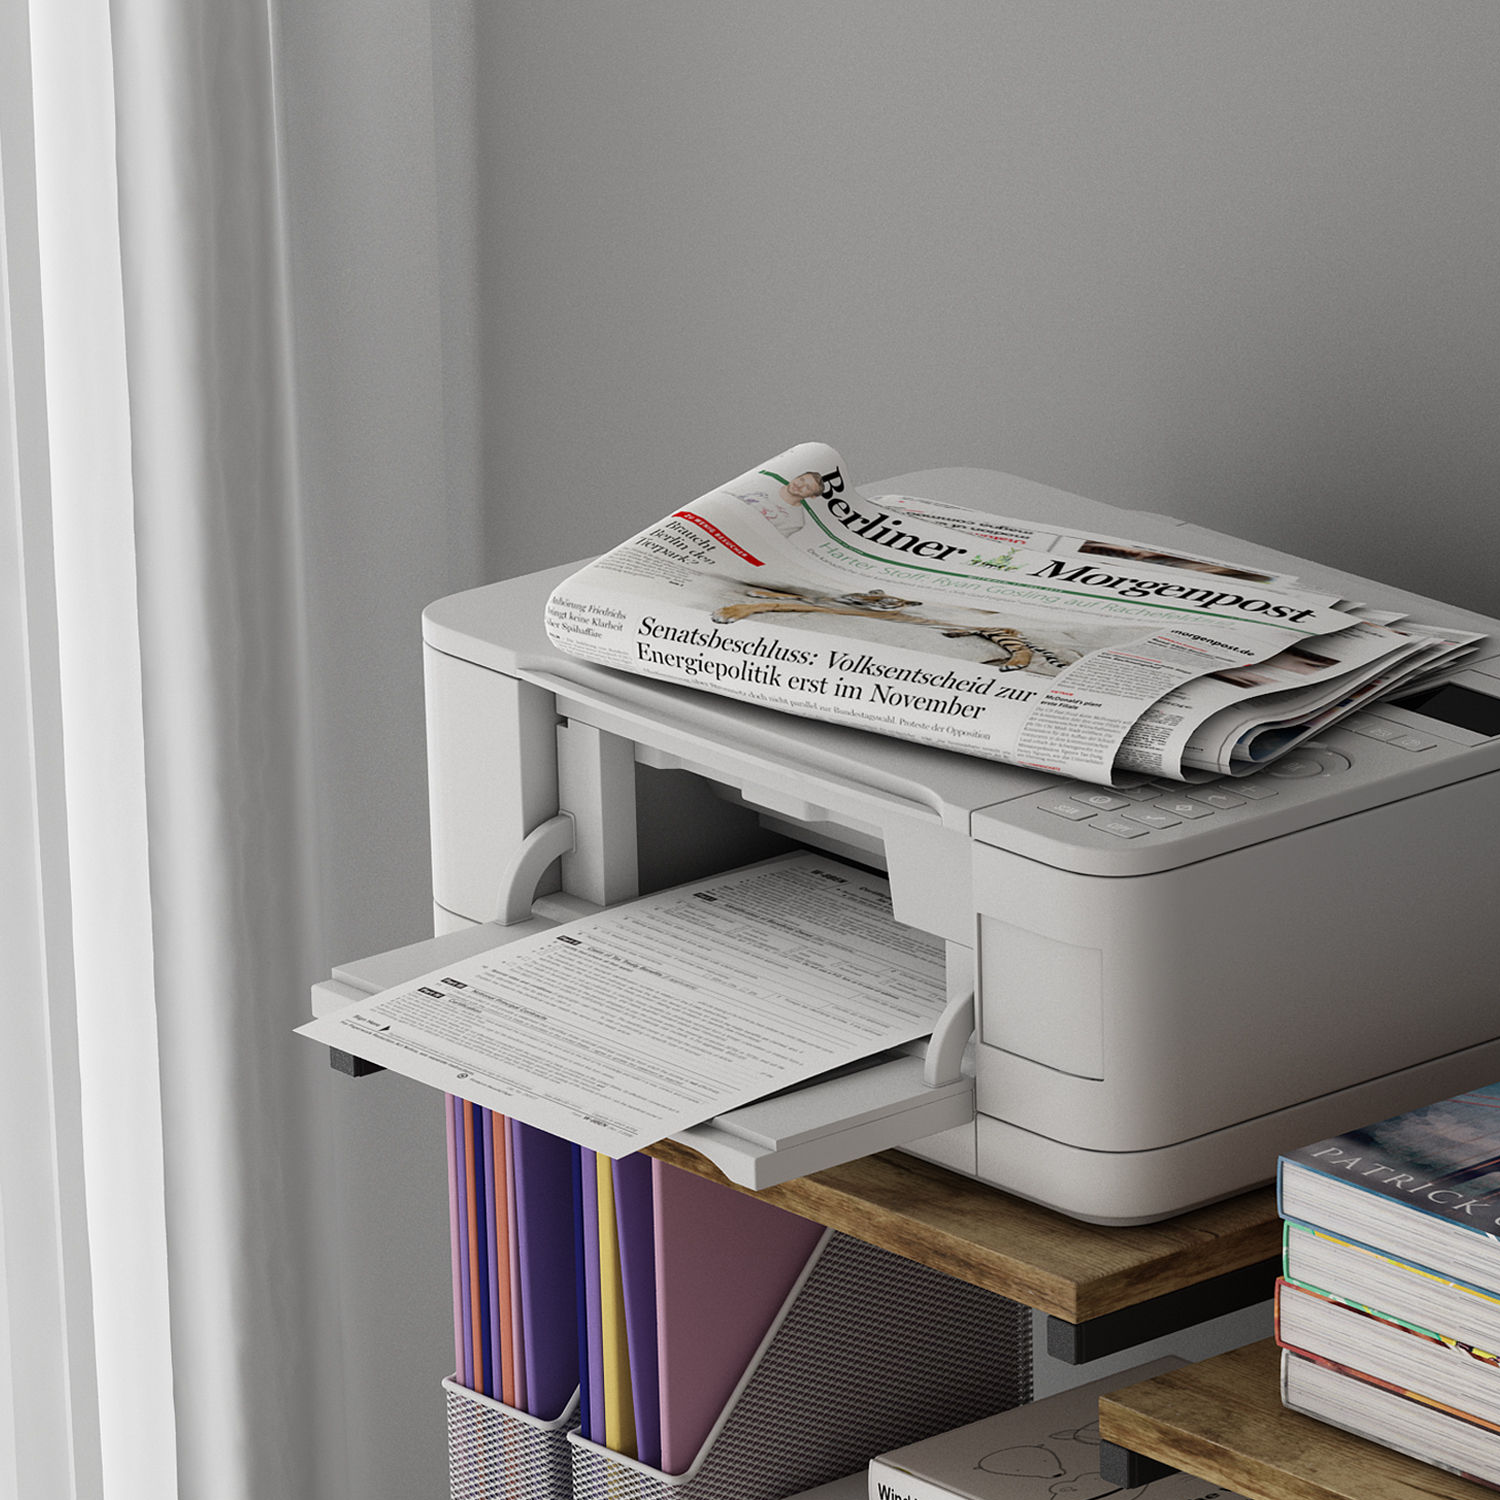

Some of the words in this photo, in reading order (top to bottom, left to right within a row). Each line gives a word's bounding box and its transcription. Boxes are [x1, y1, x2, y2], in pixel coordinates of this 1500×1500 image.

[635, 536, 701, 566] Tierpark?
[650, 528, 689, 552] Berlin
[688, 548, 716, 566] den
[665, 520, 716, 553] Braucht
[821, 466, 967, 561] Berliner
[1026, 560, 1316, 624] Morgenpost
[818, 542, 878, 571] Harter
[877, 565, 931, 584] Stoff:
[932, 575, 982, 591] Ryan
[986, 583, 1061, 604] Gosling
[1063, 596, 1099, 609] auf
[563, 611, 585, 625] keine
[591, 617, 624, 632] Klarheit
[587, 604, 627, 620] Friedrichs
[637, 615, 819, 666] Senatsbeschluss:
[827, 650, 997, 696] Volksentscheid
[994, 686, 1039, 702] zur
[1170, 628, 1256, 658] morgenpost.de
[636, 641, 783, 688] Energiepolitik
[788, 674, 829, 697] erst
[834, 676, 863, 701] im
[869, 683, 987, 720] November
[898, 717, 931, 732] Proteste
[930, 723, 946, 734] der
[945, 726, 992, 742] Opposition
[1311, 1147, 1492, 1216] PATRICK
